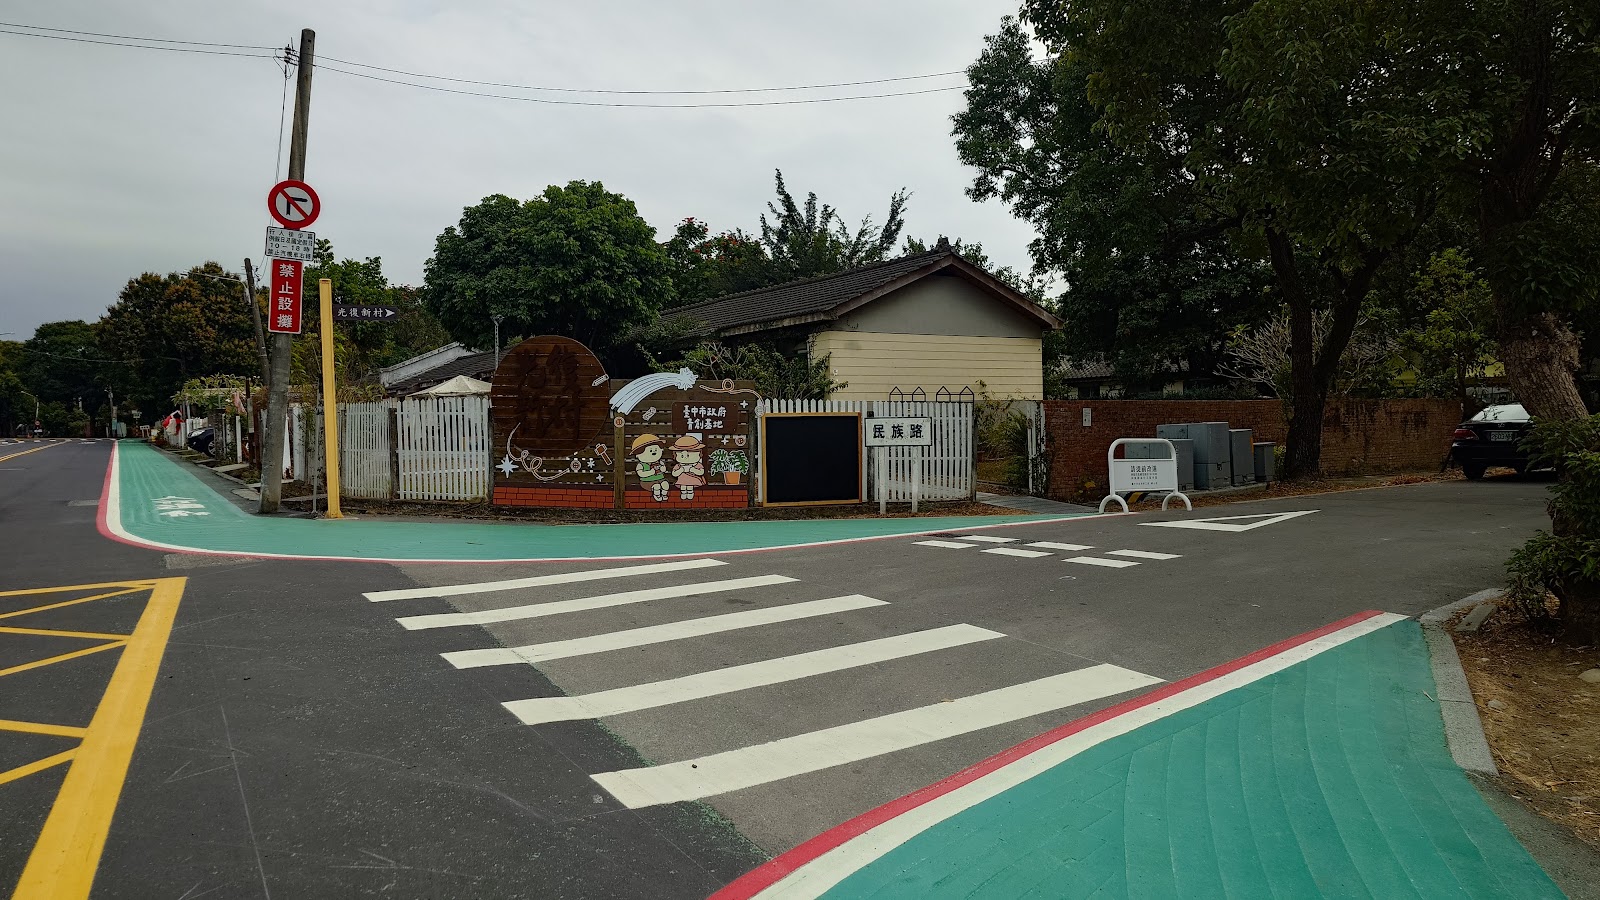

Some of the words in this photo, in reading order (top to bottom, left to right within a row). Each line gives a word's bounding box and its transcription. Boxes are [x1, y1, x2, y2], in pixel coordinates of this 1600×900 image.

[277, 263, 295, 328] 禁止設攤
[337, 307, 383, 318] 光復新村
[683, 405, 727, 418] 臺中市政府
[687, 418, 724, 430] 青創基地
[873, 424, 923, 438] 民族路
